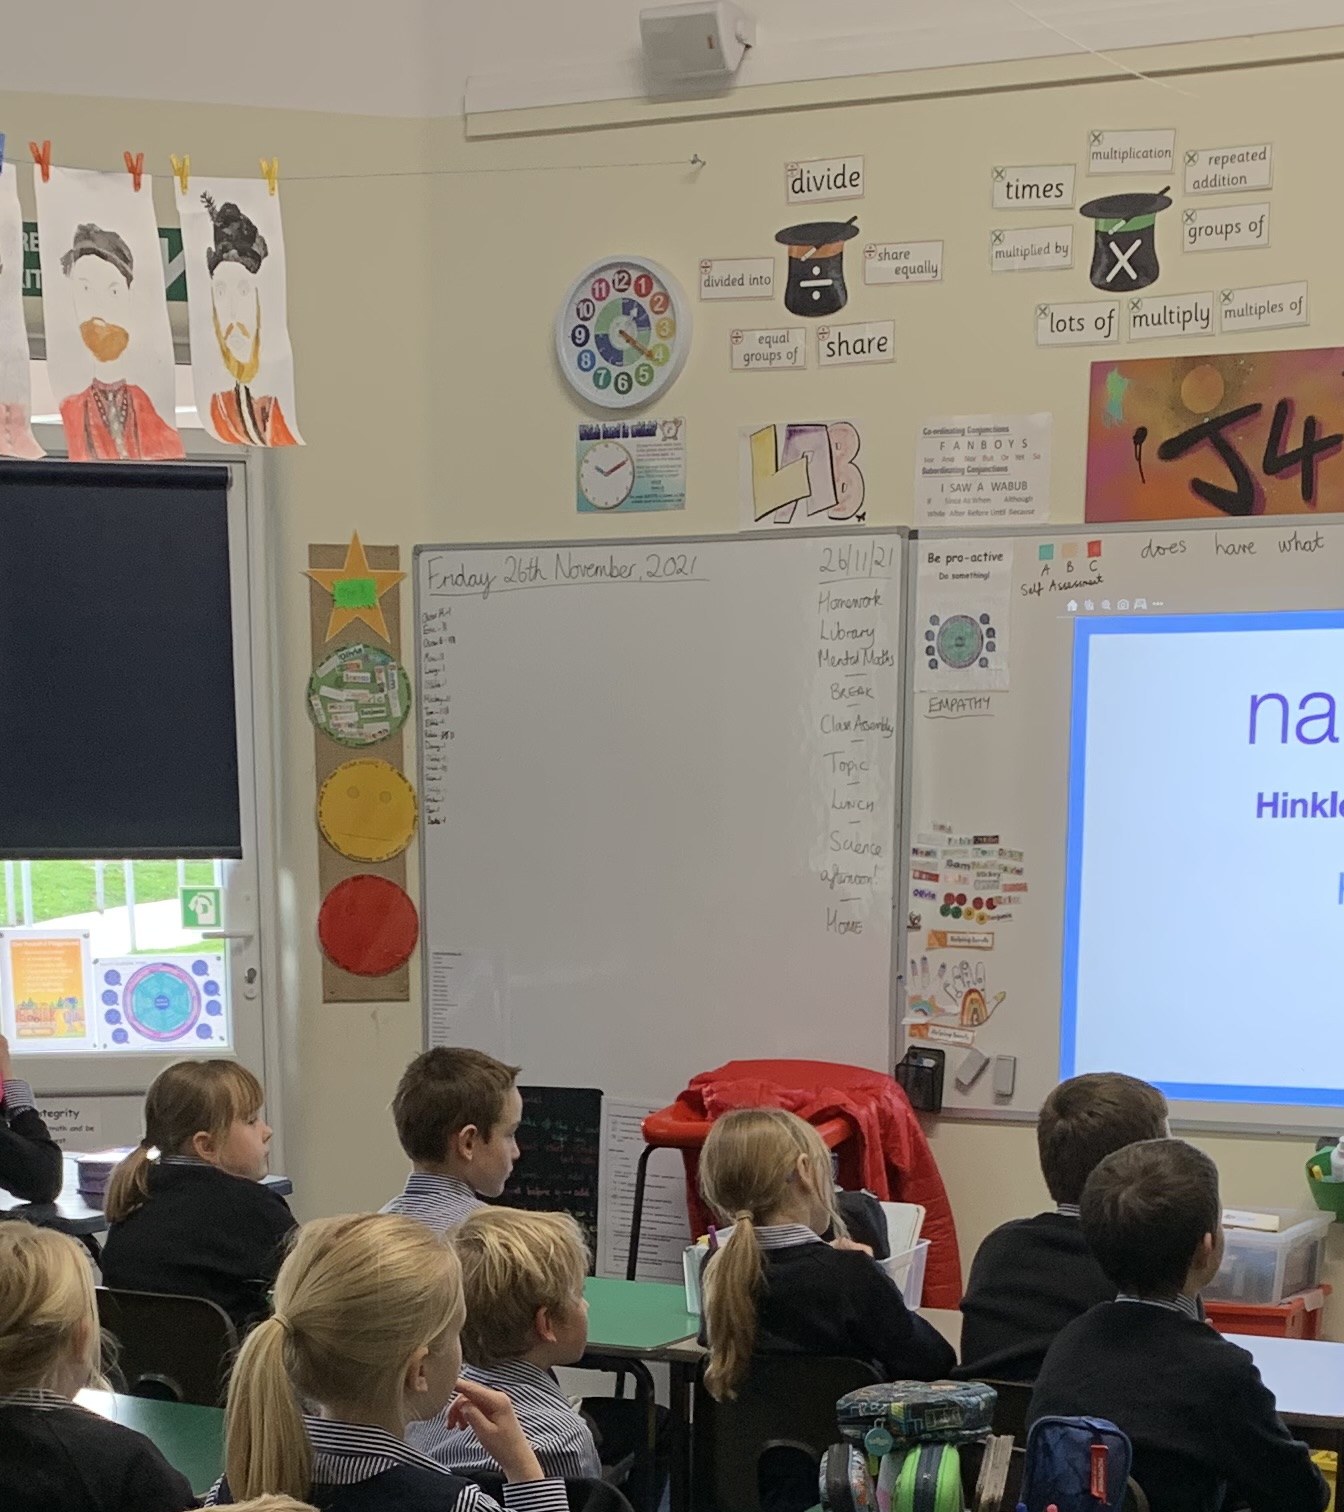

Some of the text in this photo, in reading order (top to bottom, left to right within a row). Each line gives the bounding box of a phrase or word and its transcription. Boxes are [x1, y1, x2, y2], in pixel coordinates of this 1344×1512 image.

[1091, 146, 1172, 163] multiplication
[1208, 147, 1267, 169] repeated
[791, 163, 861, 195] divide
[1192, 173, 1248, 190] addition
[1006, 180, 1065, 200] times
[1188, 215, 1266, 244] groups of
[878, 247, 911, 262] share
[995, 243, 1070, 260] multiplied by
[894, 259, 939, 280] equally
[613, 273, 631, 290] 12
[640, 278, 649, 293] 1
[703, 273, 772, 288] divided into
[593, 282, 607, 298] 11
[577, 303, 594, 318] 10
[654, 295, 665, 310] 2
[1224, 296, 1304, 321] multiples of
[1050, 308, 1115, 338] lots of
[1132, 302, 1210, 331] multiply
[575, 328, 585, 343] 9
[660, 321, 670, 336] 3
[758, 331, 790, 349] equal
[826, 332, 888, 358] share
[582, 353, 591, 368] 8
[743, 346, 799, 366] groups of
[598, 370, 607, 386] 7
[618, 375, 628, 391] 6
[639, 367, 649, 382] 5
[950, 482, 972, 493] SAW
[977, 482, 984, 492] A
[991, 481, 1028, 491] WABUB
[1142, 531, 1325, 558] does have what
[819, 540, 894, 576] 26/11/21
[927, 551, 1004, 566] Be pro-active
[428, 556, 497, 599] Friday
[646, 554, 697, 578] 2021
[939, 572, 949, 580] Do
[1041, 560, 1098, 577] A B C
[1020, 582, 1044, 596] Self
[820, 619, 875, 649] Library
[830, 682, 875, 699] BREAK
[929, 696, 991, 713] EMPATHY
[823, 750, 870, 777] Topic
[829, 830, 883, 858] Science
[825, 907, 863, 935] HOME
